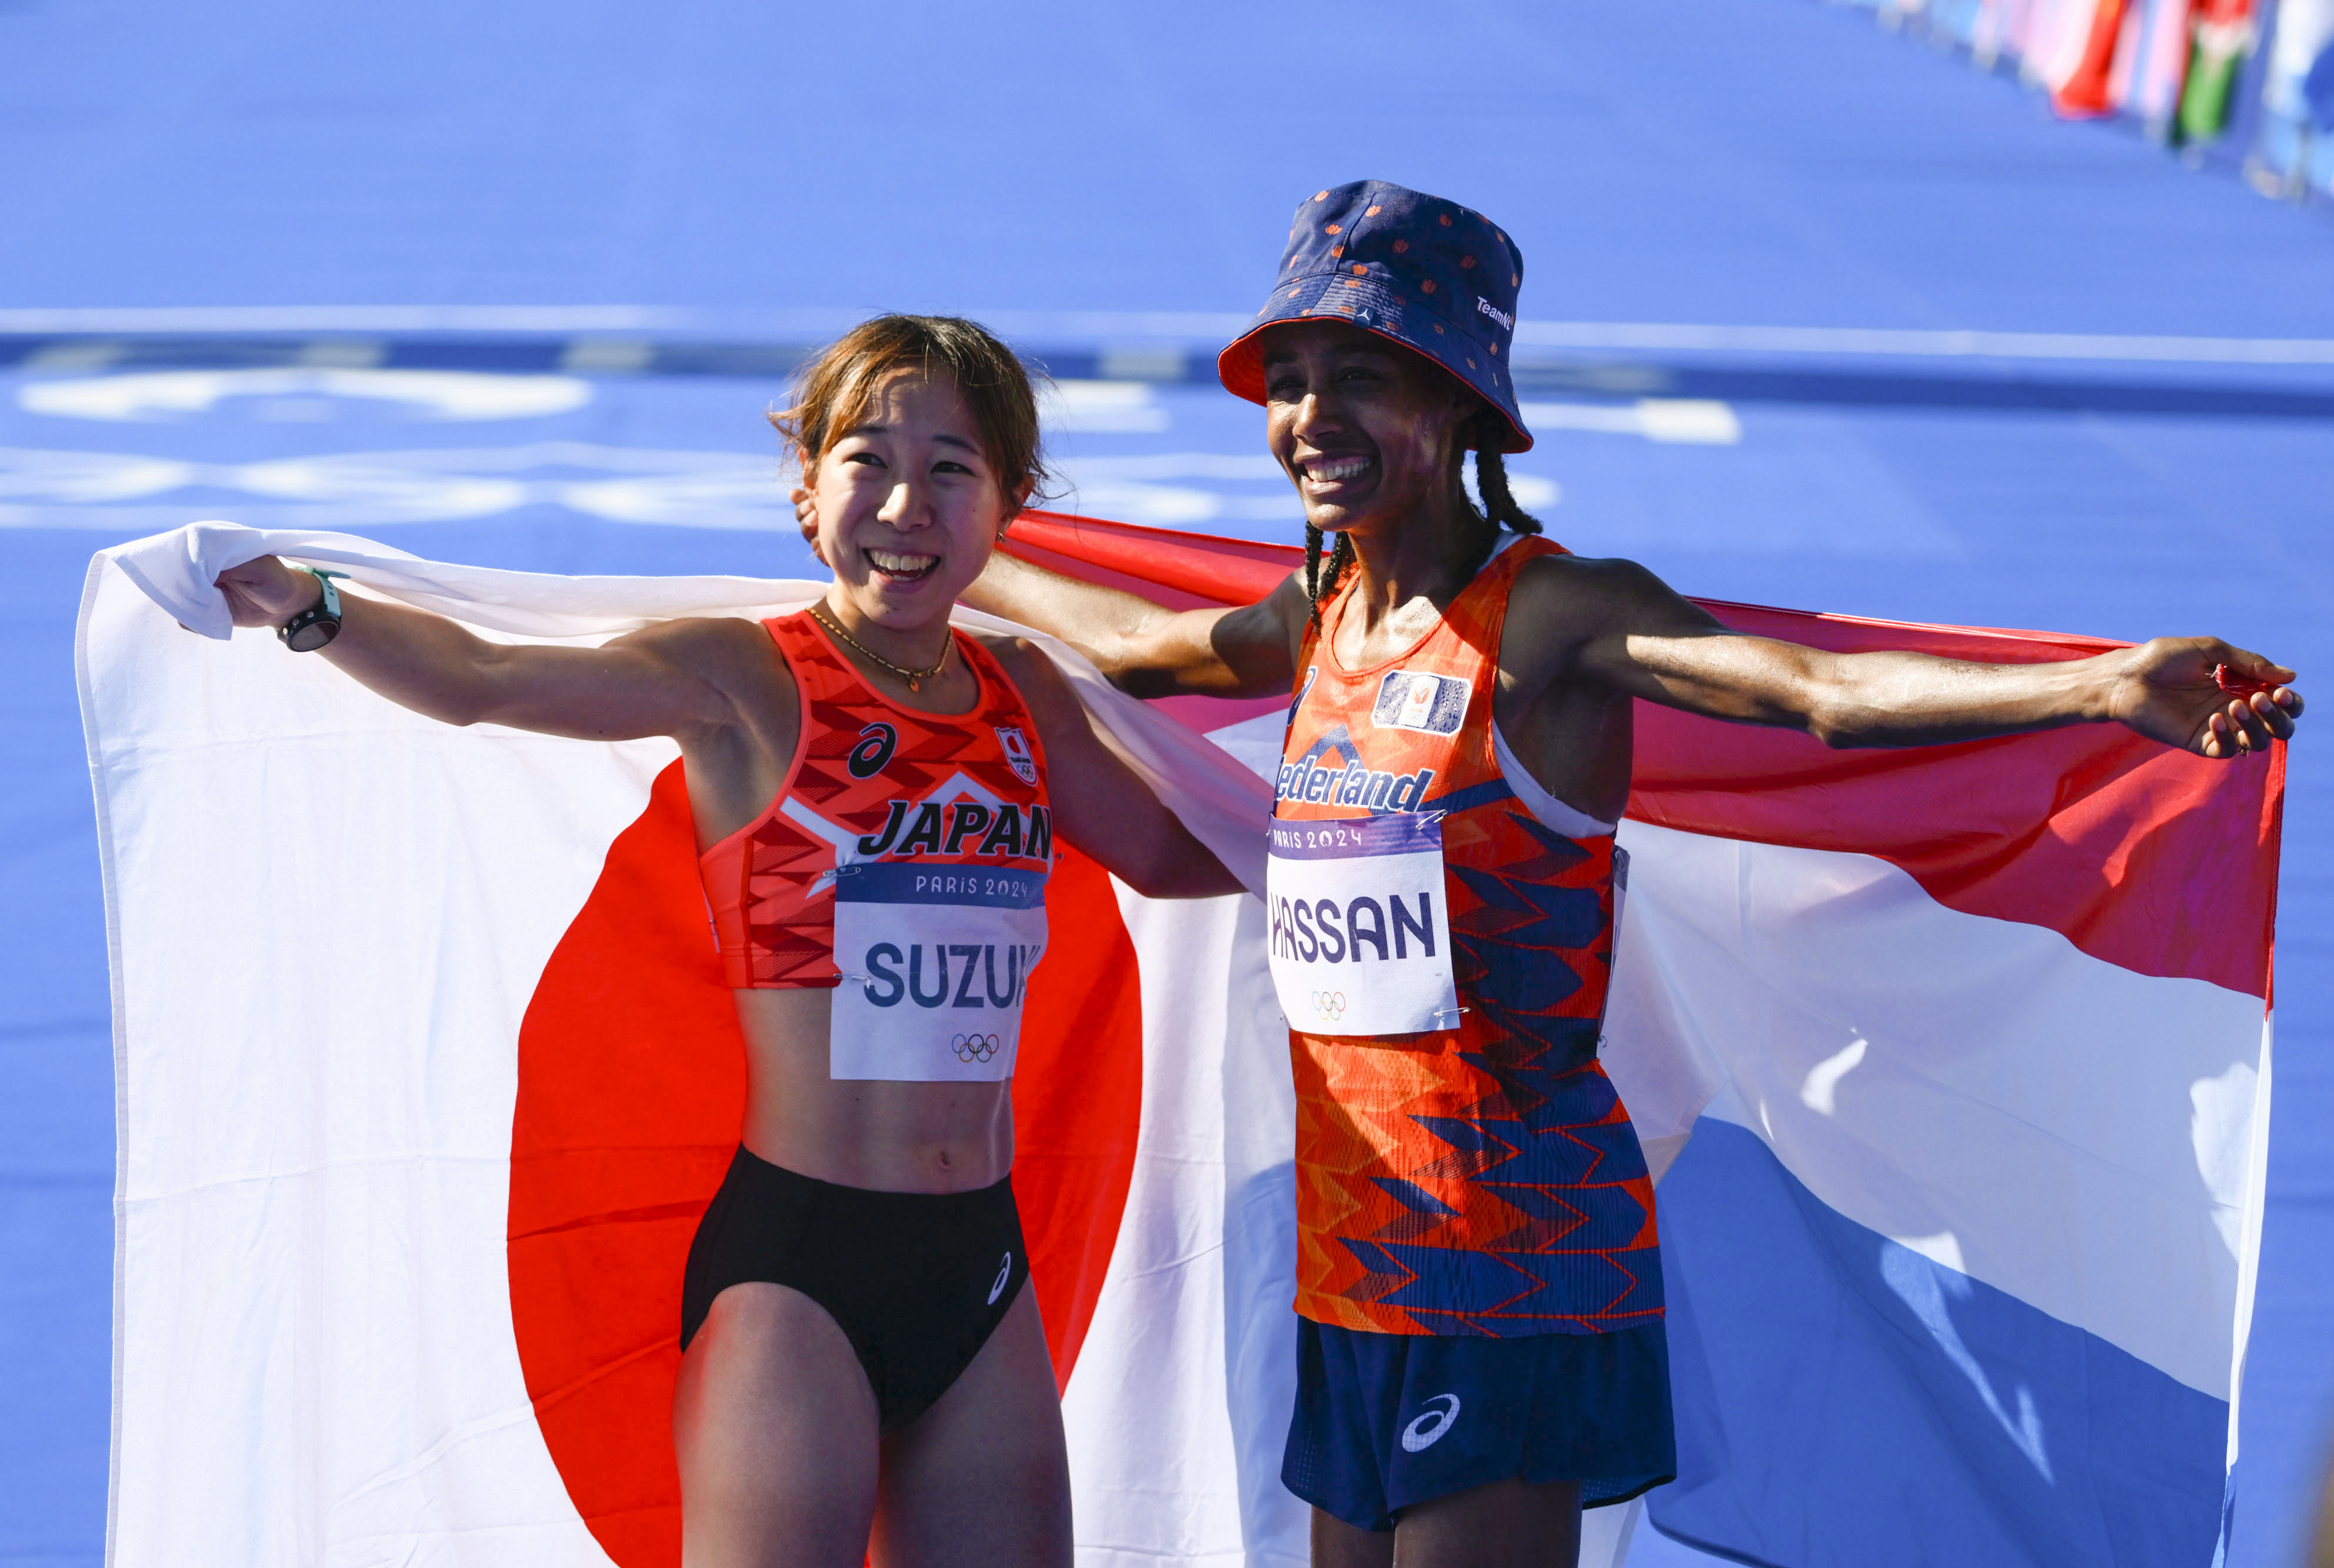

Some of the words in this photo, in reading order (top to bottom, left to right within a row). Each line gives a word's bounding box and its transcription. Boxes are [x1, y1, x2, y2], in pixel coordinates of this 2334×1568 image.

[1276, 755, 1436, 813] ederland
[857, 800, 1052, 860] JAPAN
[1306, 826, 1362, 848] 2024
[986, 879, 1028, 897] 2024
[1271, 892, 1436, 963] HASSAN
